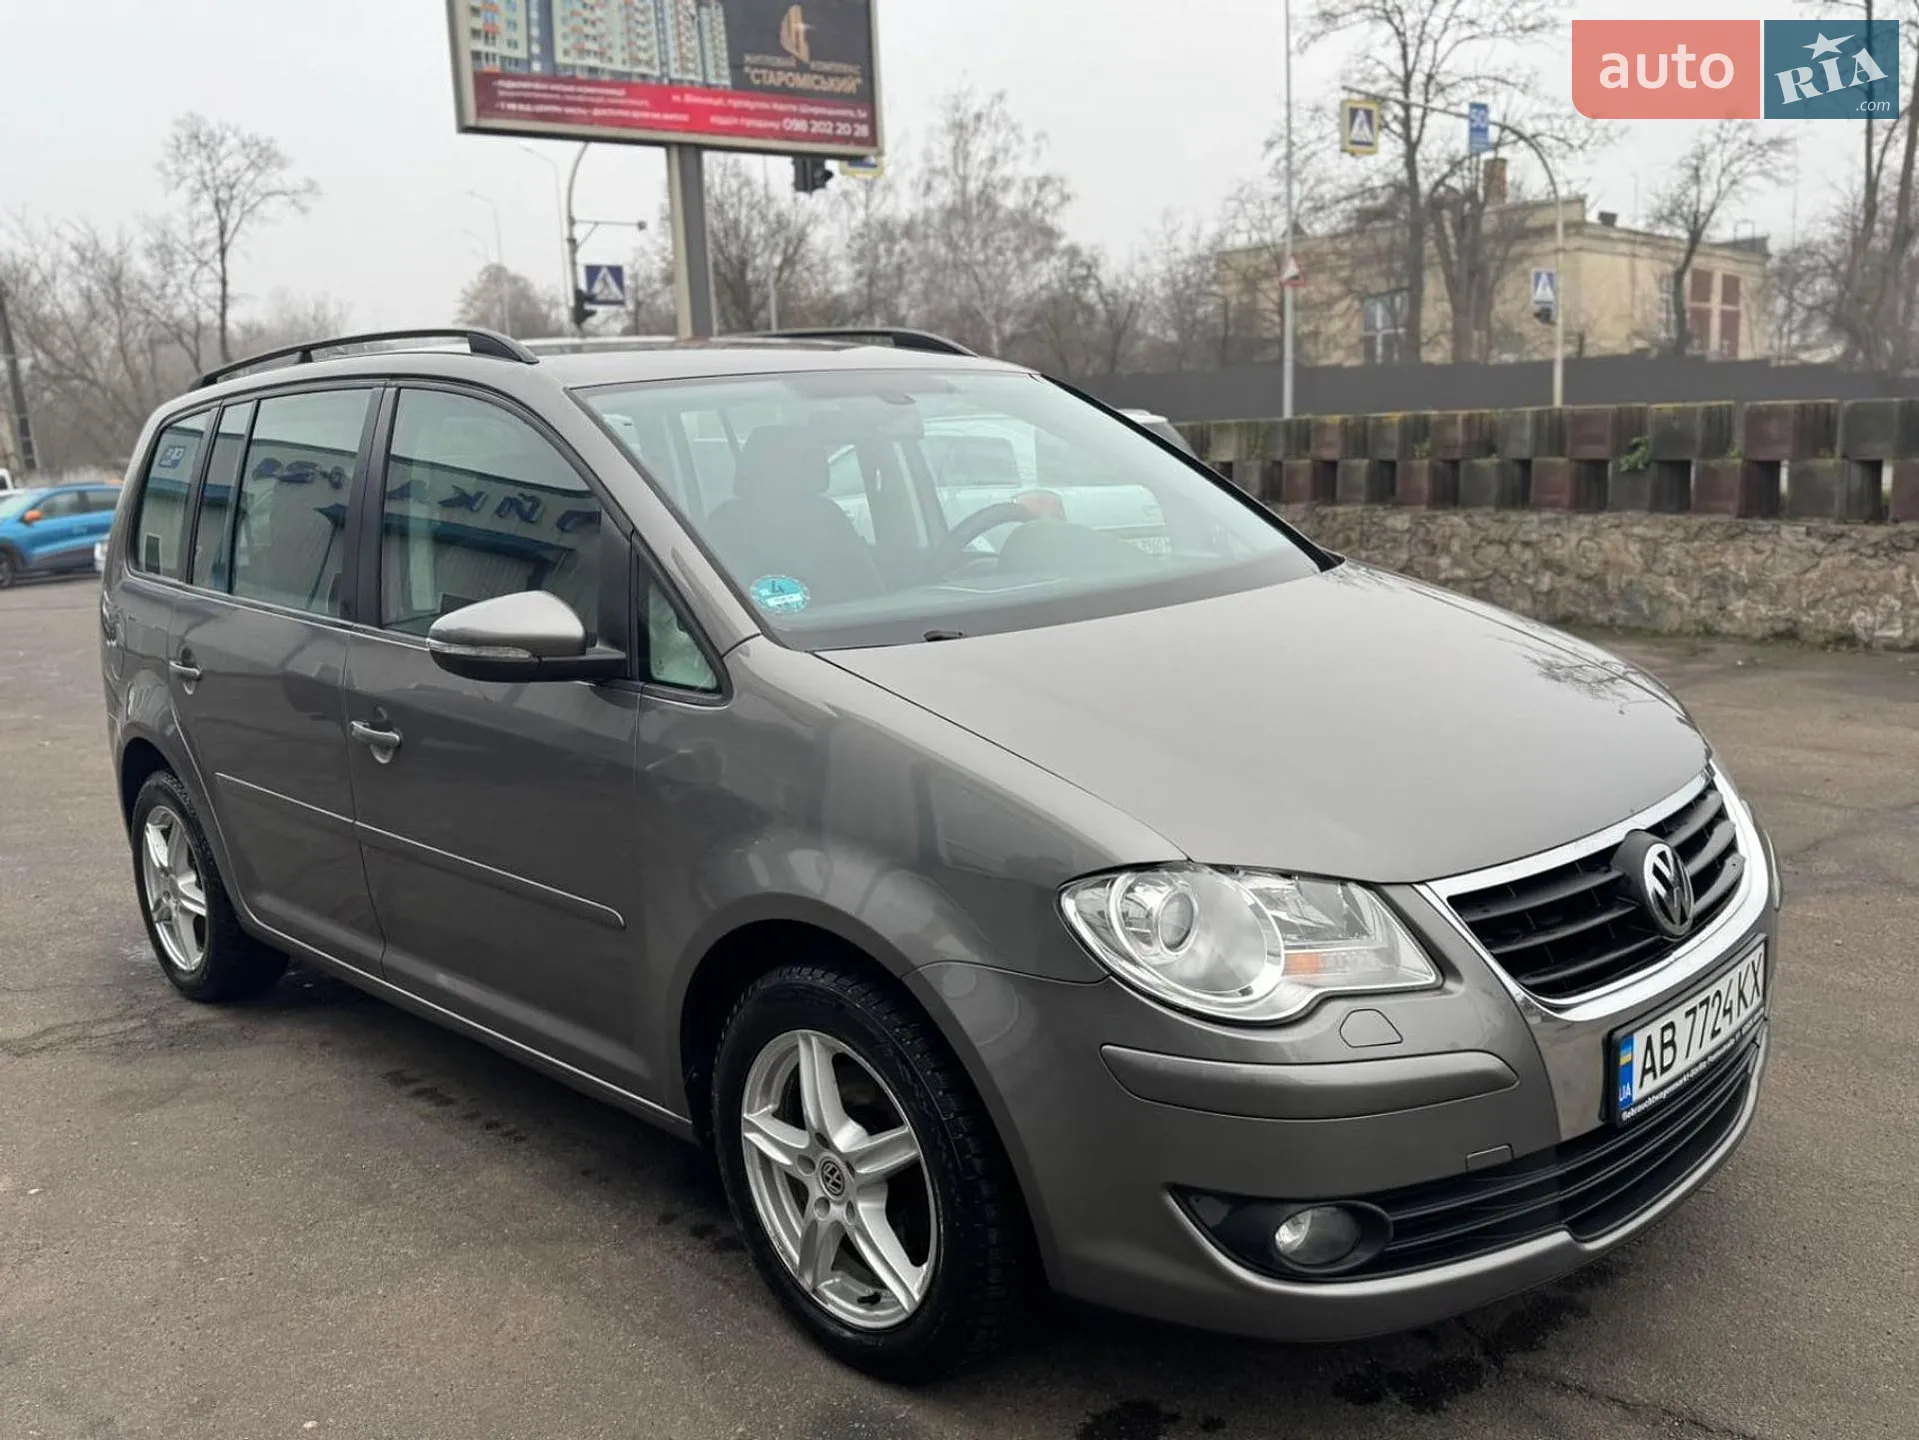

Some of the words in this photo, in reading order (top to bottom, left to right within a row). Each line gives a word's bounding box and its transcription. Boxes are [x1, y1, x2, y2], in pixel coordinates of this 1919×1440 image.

[809, 120, 834, 135] 202
[835, 121, 852, 136] 20
[1639, 1020, 1677, 1090] AB
[1685, 978, 1734, 1060] 7724
[1737, 952, 1763, 1018] KX
[1619, 1082, 1632, 1101] UA
